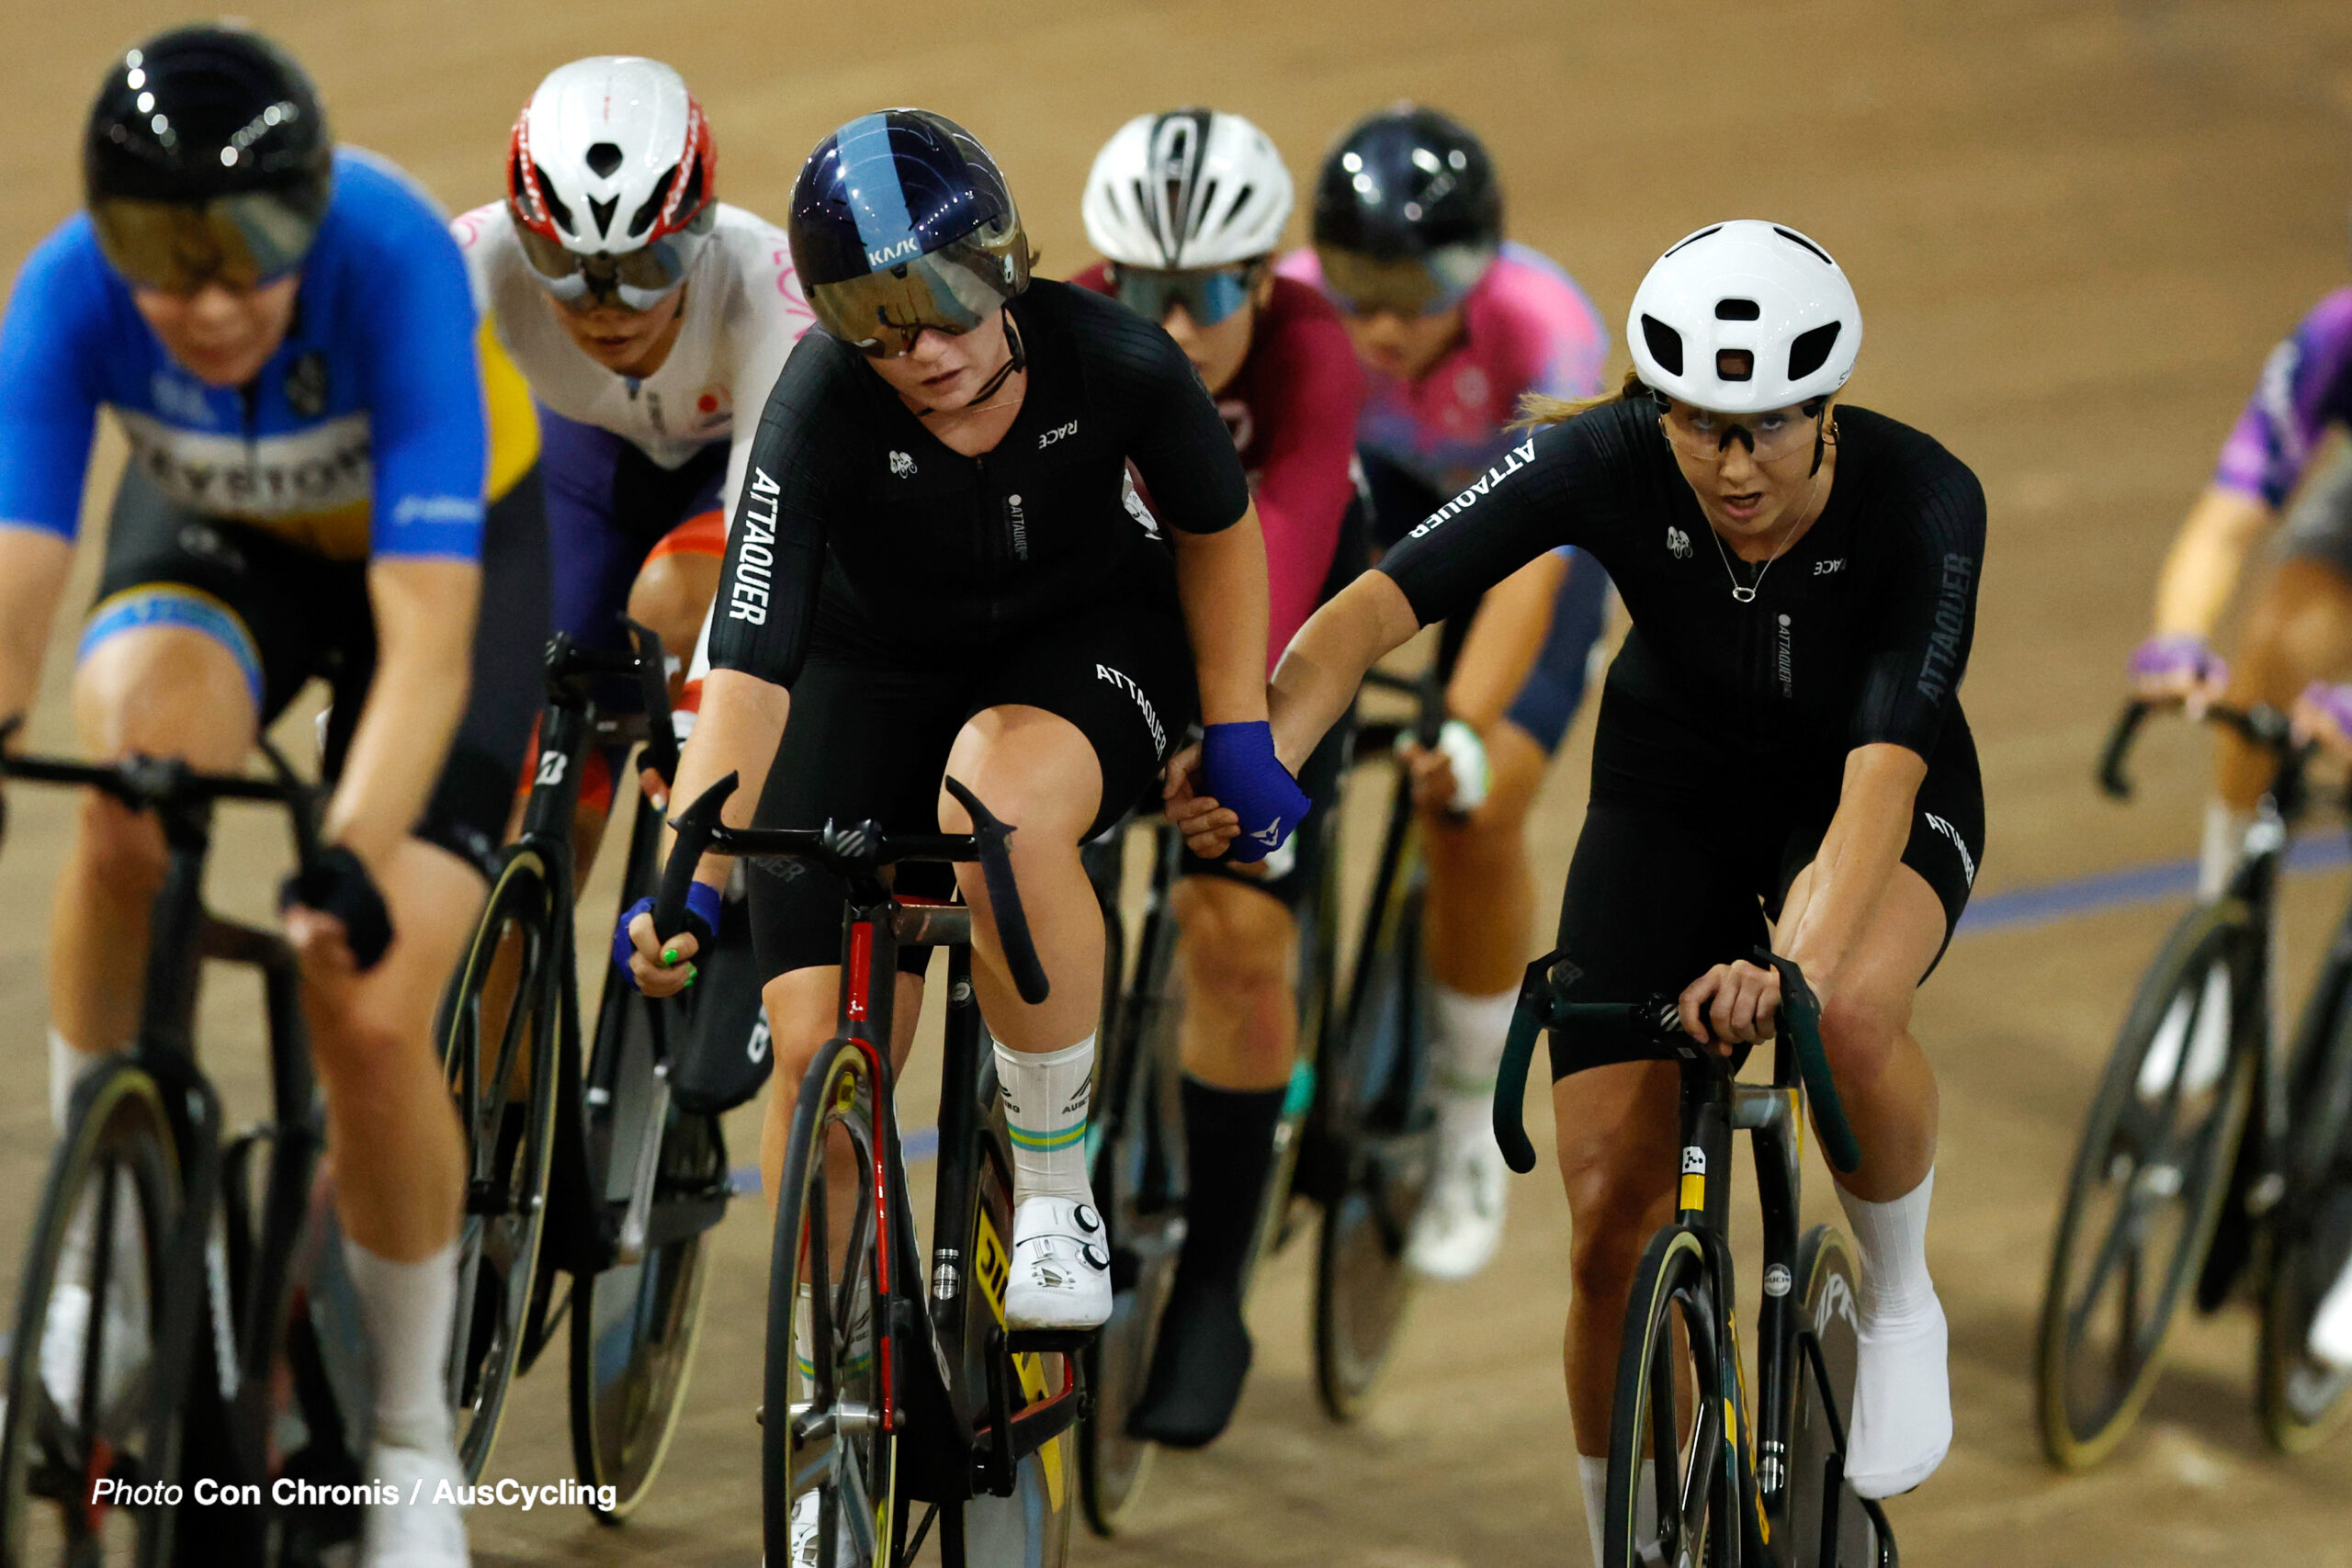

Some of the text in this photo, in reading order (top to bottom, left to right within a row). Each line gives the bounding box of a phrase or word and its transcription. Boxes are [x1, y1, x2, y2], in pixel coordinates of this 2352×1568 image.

[868, 237, 918, 266] KASK
[1038, 420, 1078, 449] RACE
[1408, 437, 1536, 538] ATTAQUER
[729, 466, 781, 626] ATTAQUER
[1778, 625, 1792, 682] ATTAQUER
[1917, 552, 1973, 708] ATTAQUER
[1096, 663, 1167, 761] ATTAQUER
